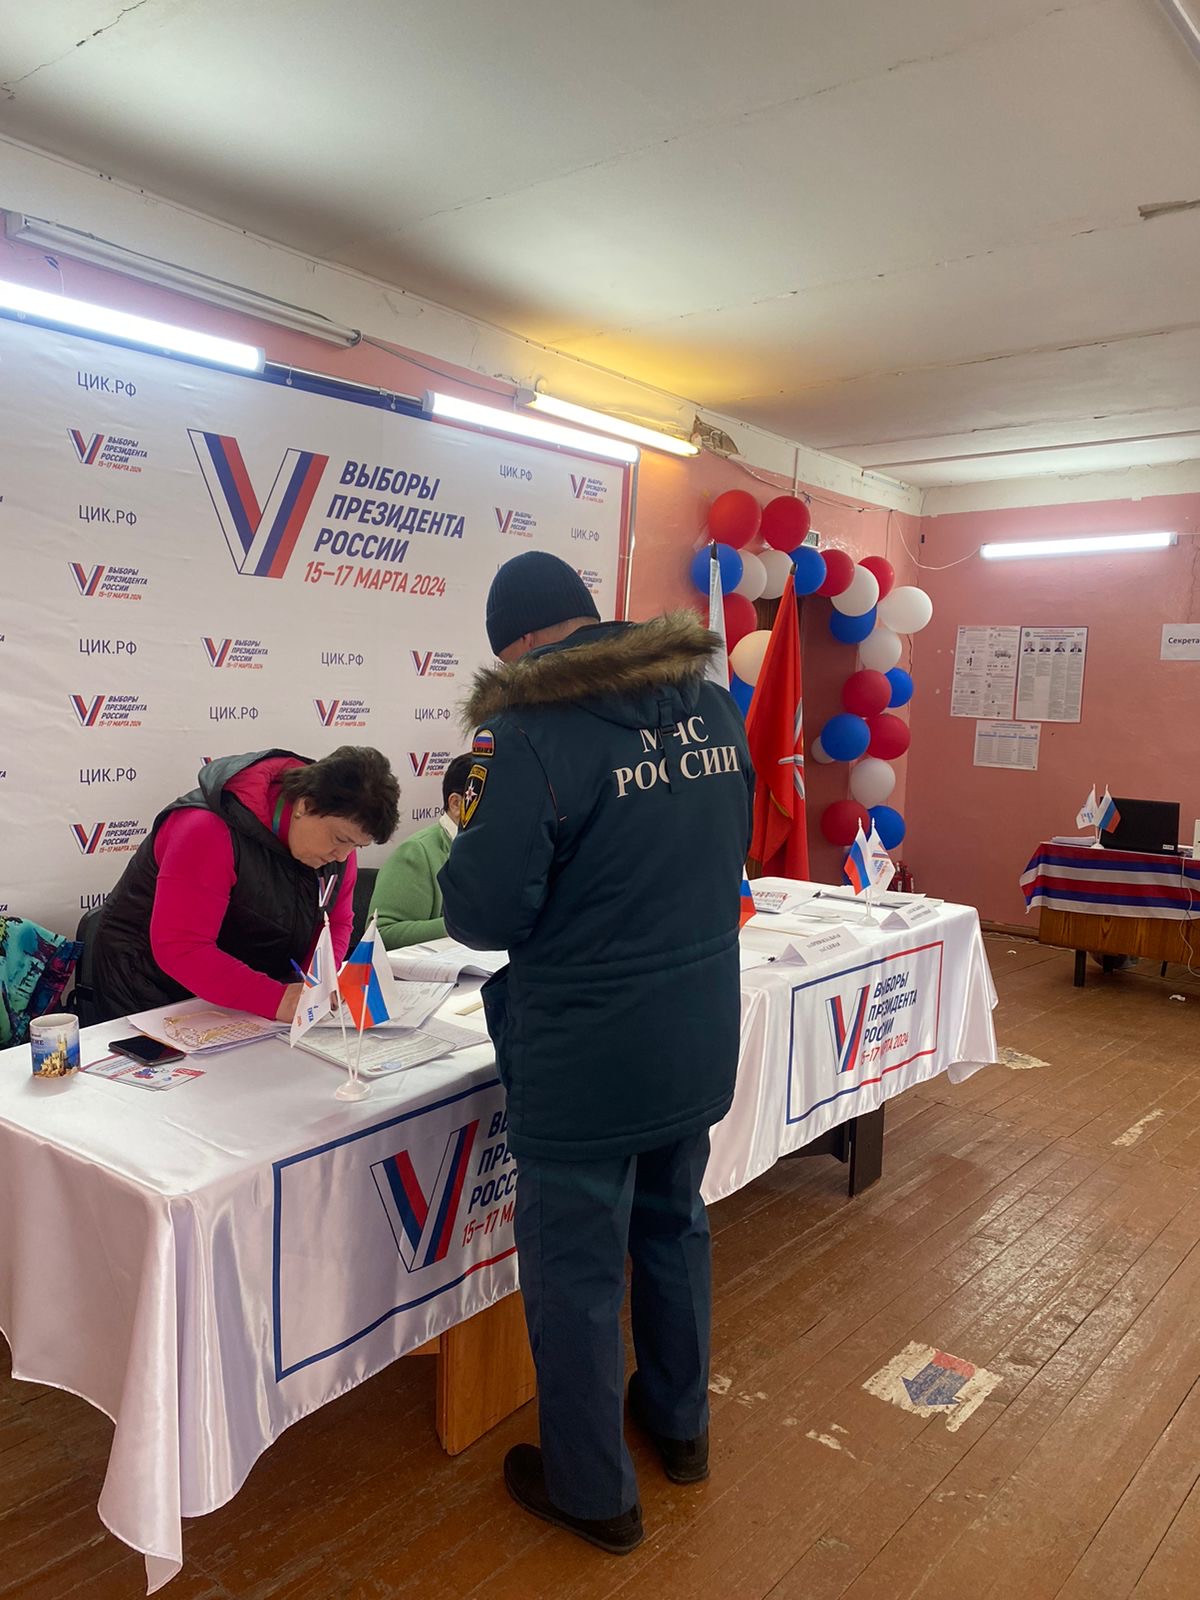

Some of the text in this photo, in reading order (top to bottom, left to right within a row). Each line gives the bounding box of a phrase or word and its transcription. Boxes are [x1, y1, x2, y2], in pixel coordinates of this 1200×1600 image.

[78, 371, 136, 396] ЦИК.РФ
[107, 436, 139, 448] ВЫБОРЫ
[100, 452, 129, 463] РОССИИ
[104, 444, 148, 458] ПРЕЗИДЕНТА
[339, 460, 440, 501] ВЫБОРЫ
[500, 464, 532, 482] ЦИК.РФ
[78, 504, 137, 526] ЦИК.РФ
[326, 494, 465, 539] ПРЕЗИДЕНТА
[571, 527, 600, 542] ЦИК.РФ
[314, 528, 410, 563] РОССИИ
[108, 566, 139, 576] ВЫБОРЫ
[304, 560, 446, 597] 15–17 МАРТА 2024
[101, 583, 129, 591] РОССИИ
[104, 575, 148, 585] ПРЕЗИДЕНТА
[80, 638, 137, 656] ЦИК.РФ
[1168, 637, 1200, 645] Секрета
[322, 652, 364, 667] ЦИК.РФ
[209, 706, 259, 722] ЦИК.РФ
[415, 708, 450, 720] ЦИК.РФ
[80, 768, 137, 786] ЦИК.РФ
[105, 829, 147, 837] ПРЕЗИДЕНТА
[468, 1168, 518, 1214] РОСС
